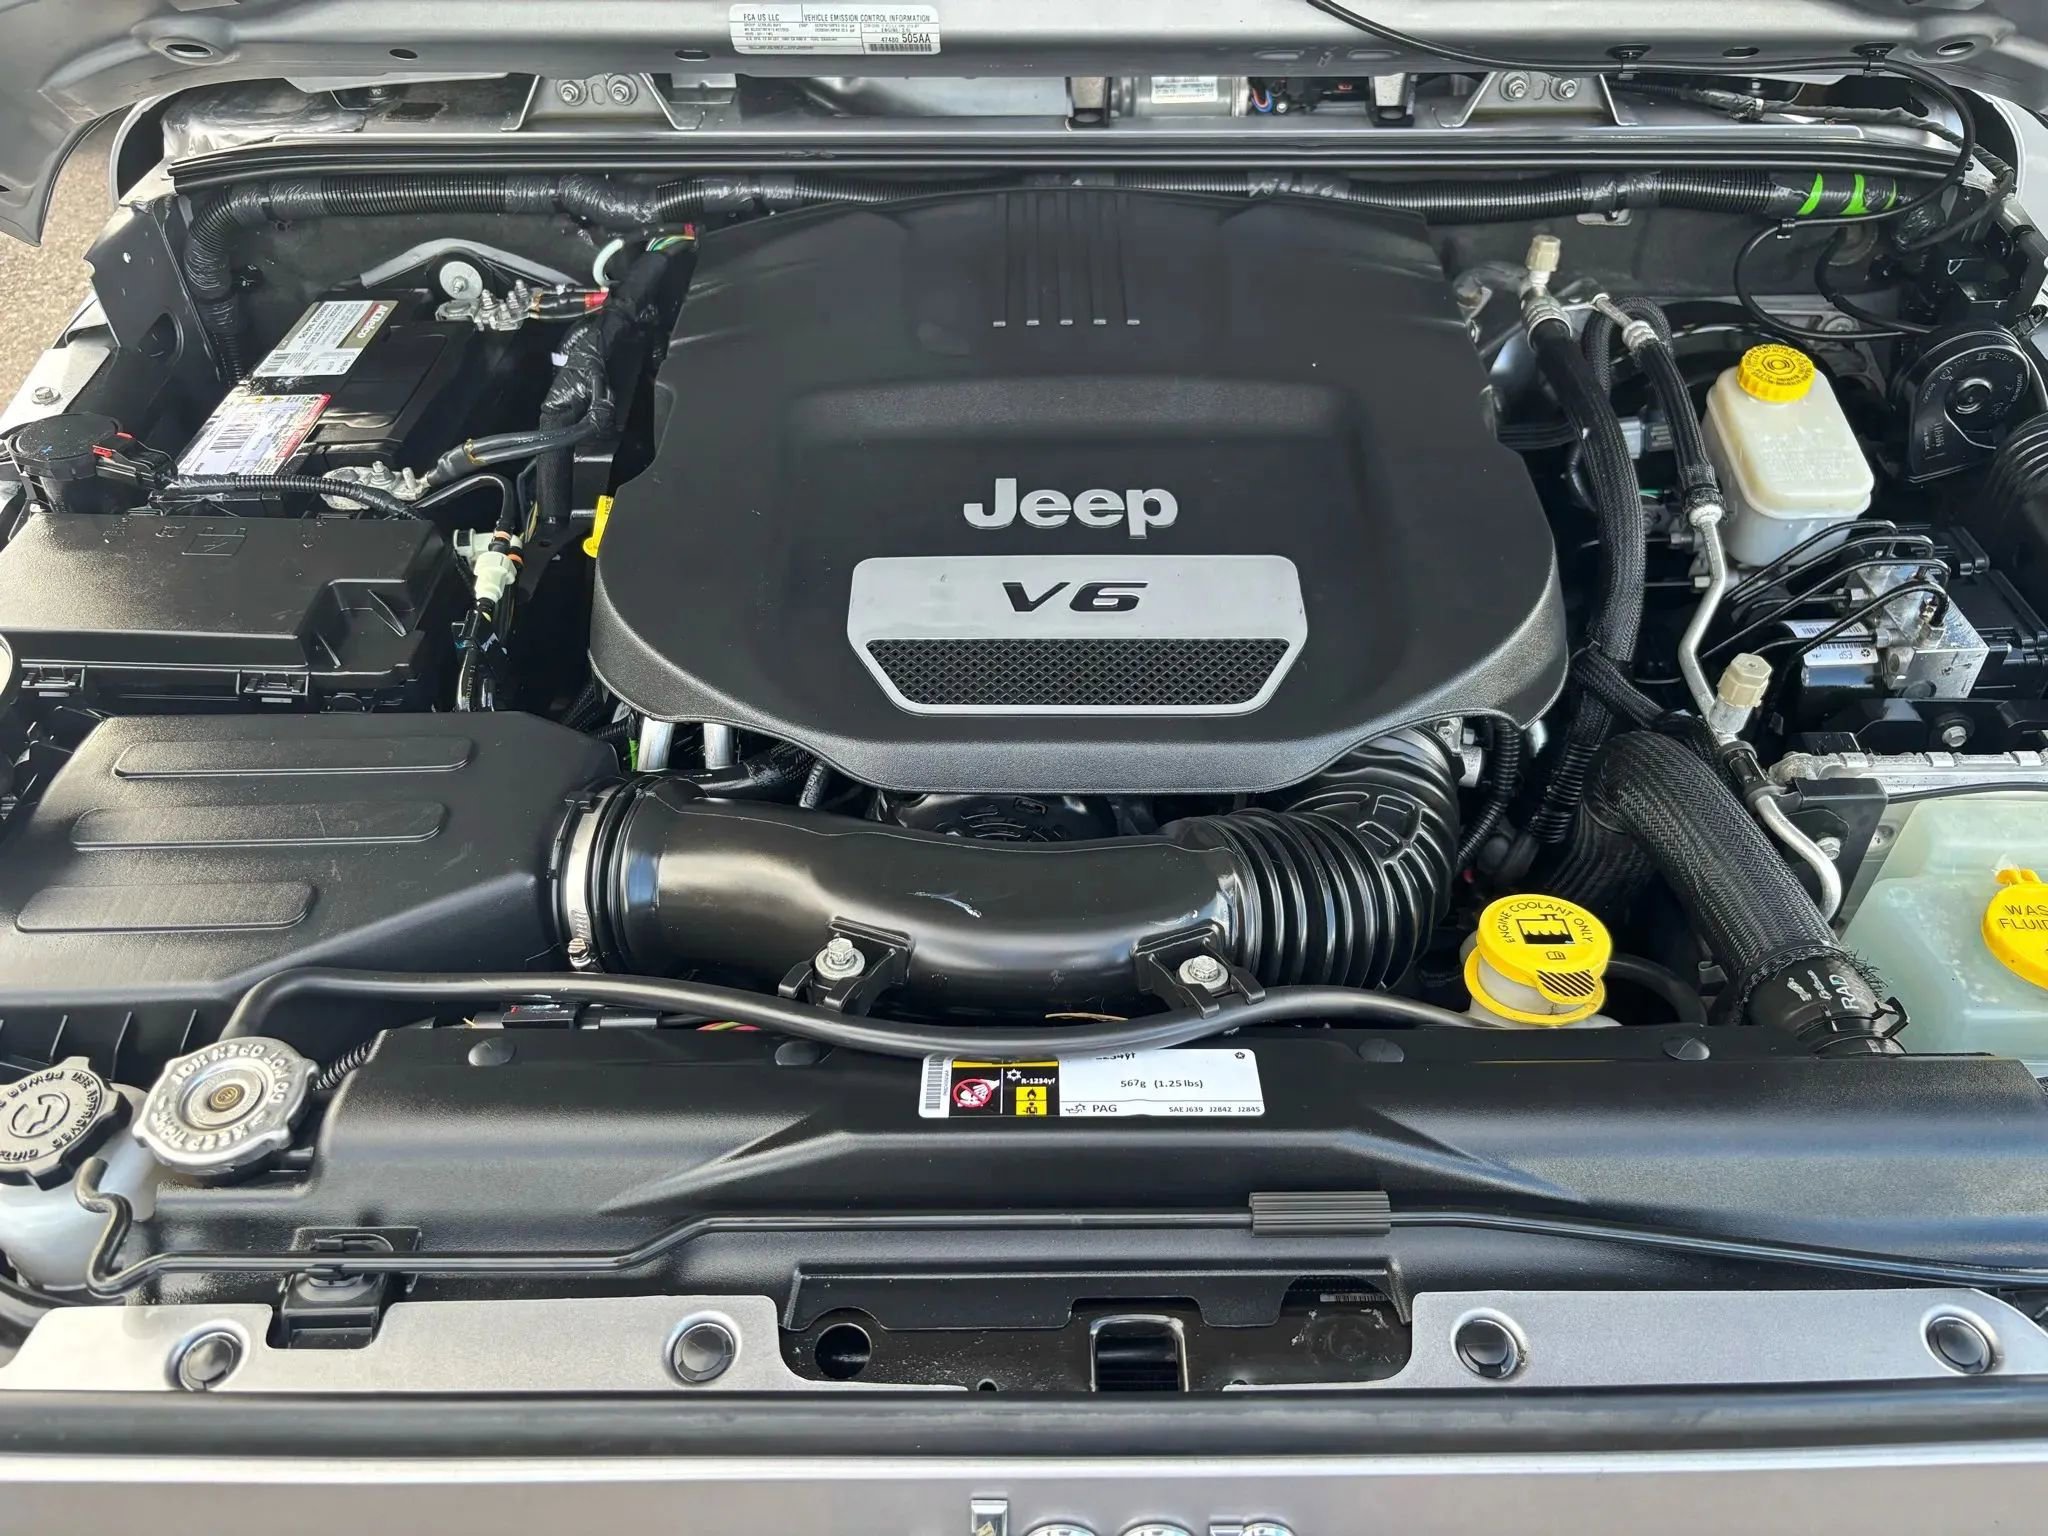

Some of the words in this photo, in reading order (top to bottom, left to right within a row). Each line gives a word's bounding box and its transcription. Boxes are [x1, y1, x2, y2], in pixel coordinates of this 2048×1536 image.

[743, 13, 756, 21] FCA
[757, 13, 767, 21] US
[768, 13, 780, 21] LLC
[830, 14, 859, 22] EMISSION
[860, 14, 888, 22] CONTROL
[889, 14, 930, 23] INFORMATION
[901, 33, 931, 44] 505AA
[963, 477, 1179, 540] Jeep
[1002, 580, 1149, 613] V6
[1497, 910, 1516, 944] ENGINE
[1508, 901, 1575, 917] COOLANT
[1573, 917, 1594, 943] ONLY
[1828, 974, 1860, 1010] RAD
[211, 1043, 266, 1062] OPEN
[7, 1070, 65, 1098] POWER
[171, 1055, 210, 1085] HOT
[1020, 1077, 1056, 1085] R-1234yf
[1120, 1079, 1147, 1089] 567g
[1153, 1079, 1182, 1089] (1.25
[1183, 1079, 1204, 1089] lbs)
[51, 1088, 99, 1151] APPROVED
[1092, 1104, 1118, 1113] PAG
[184, 1123, 250, 1151] KEEP
